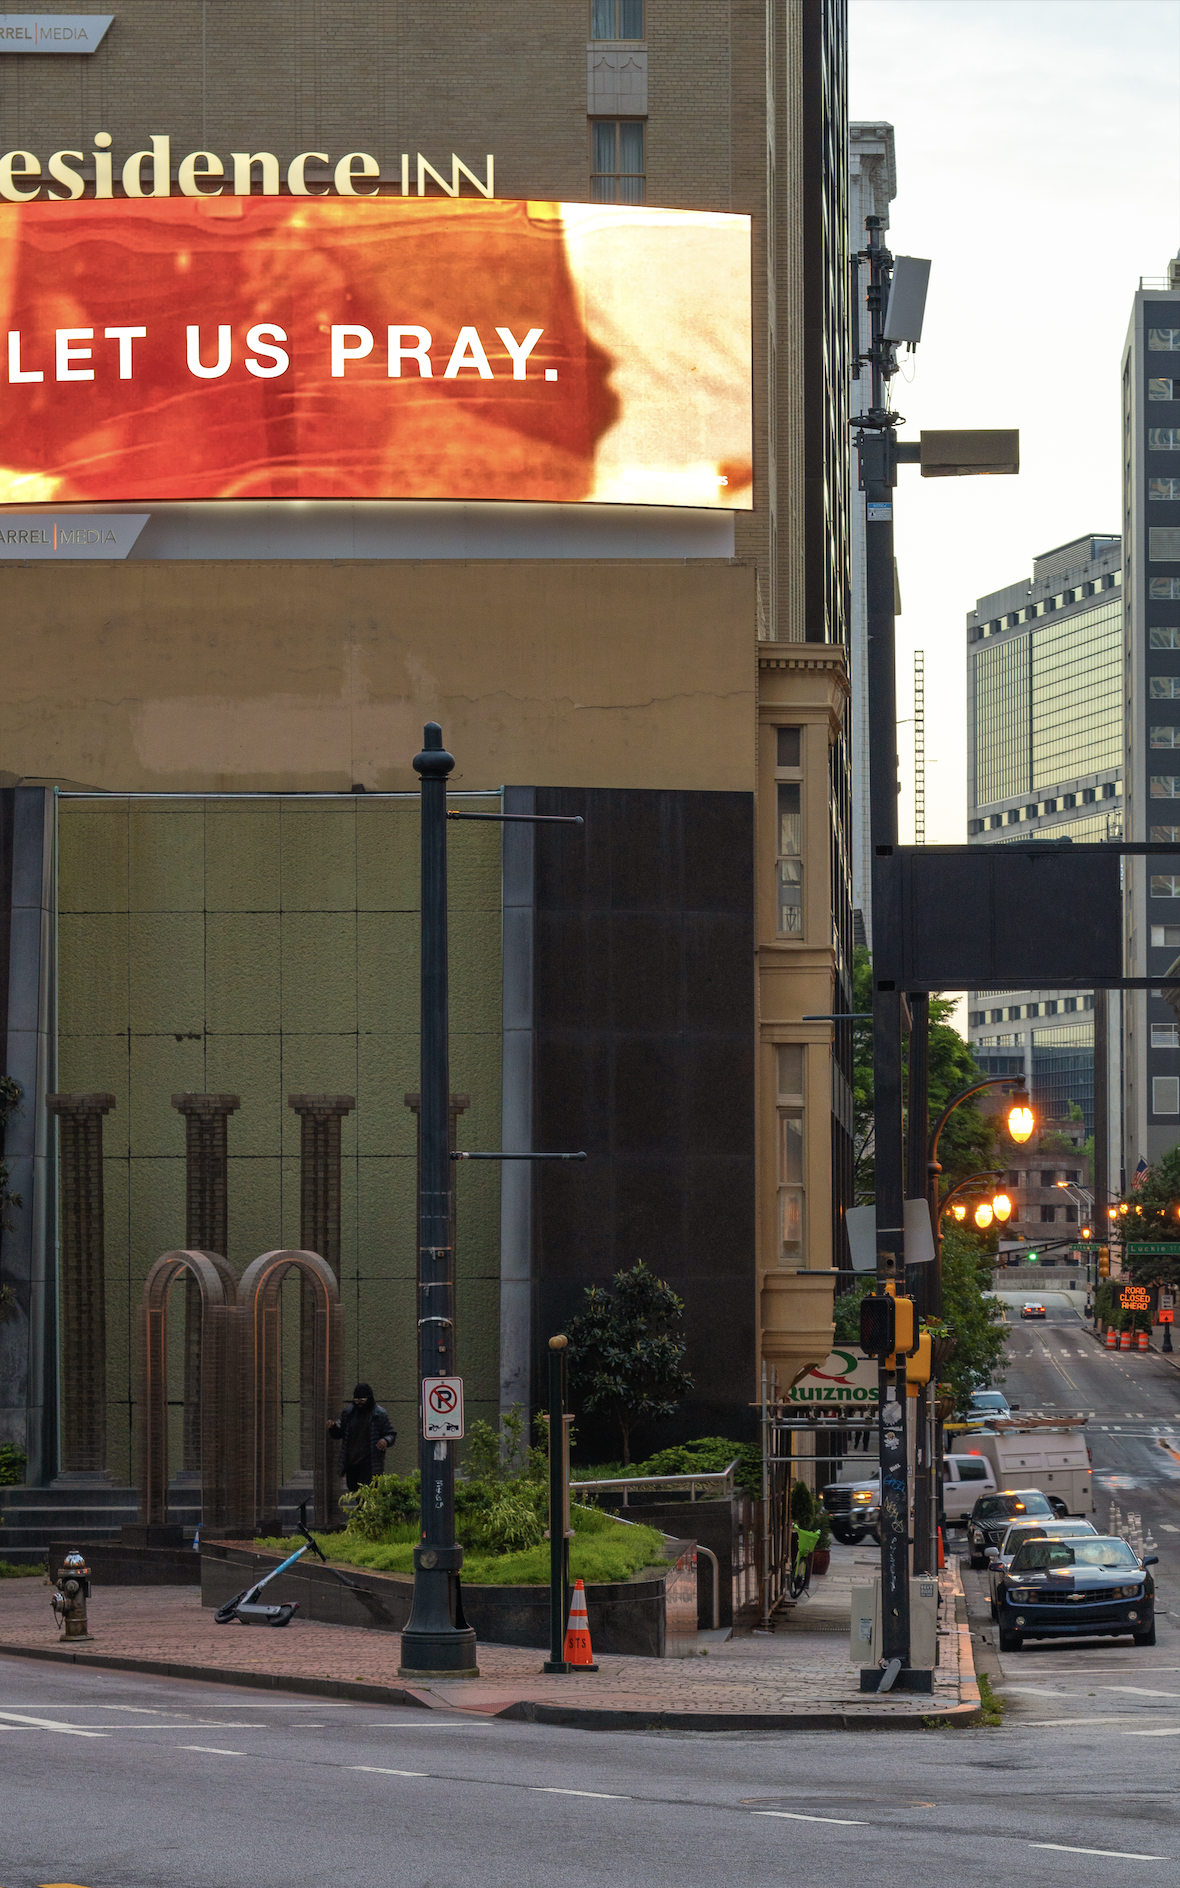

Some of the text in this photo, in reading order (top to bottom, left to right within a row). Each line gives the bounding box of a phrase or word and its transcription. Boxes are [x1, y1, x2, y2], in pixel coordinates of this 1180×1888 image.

[39, 27, 89, 40] MEDIA
[402, 152, 495, 199] INN
[7, 323, 560, 384] LET US PRAY.
[59, 529, 117, 544] MEDIA
[1130, 1244, 1166, 1252] Luckie
[1124, 1286, 1147, 1295] ROAD
[1119, 1293, 1151, 1303] CLOSED
[1121, 1302, 1148, 1311] AHEAD
[568, 1637, 587, 1649] STS
